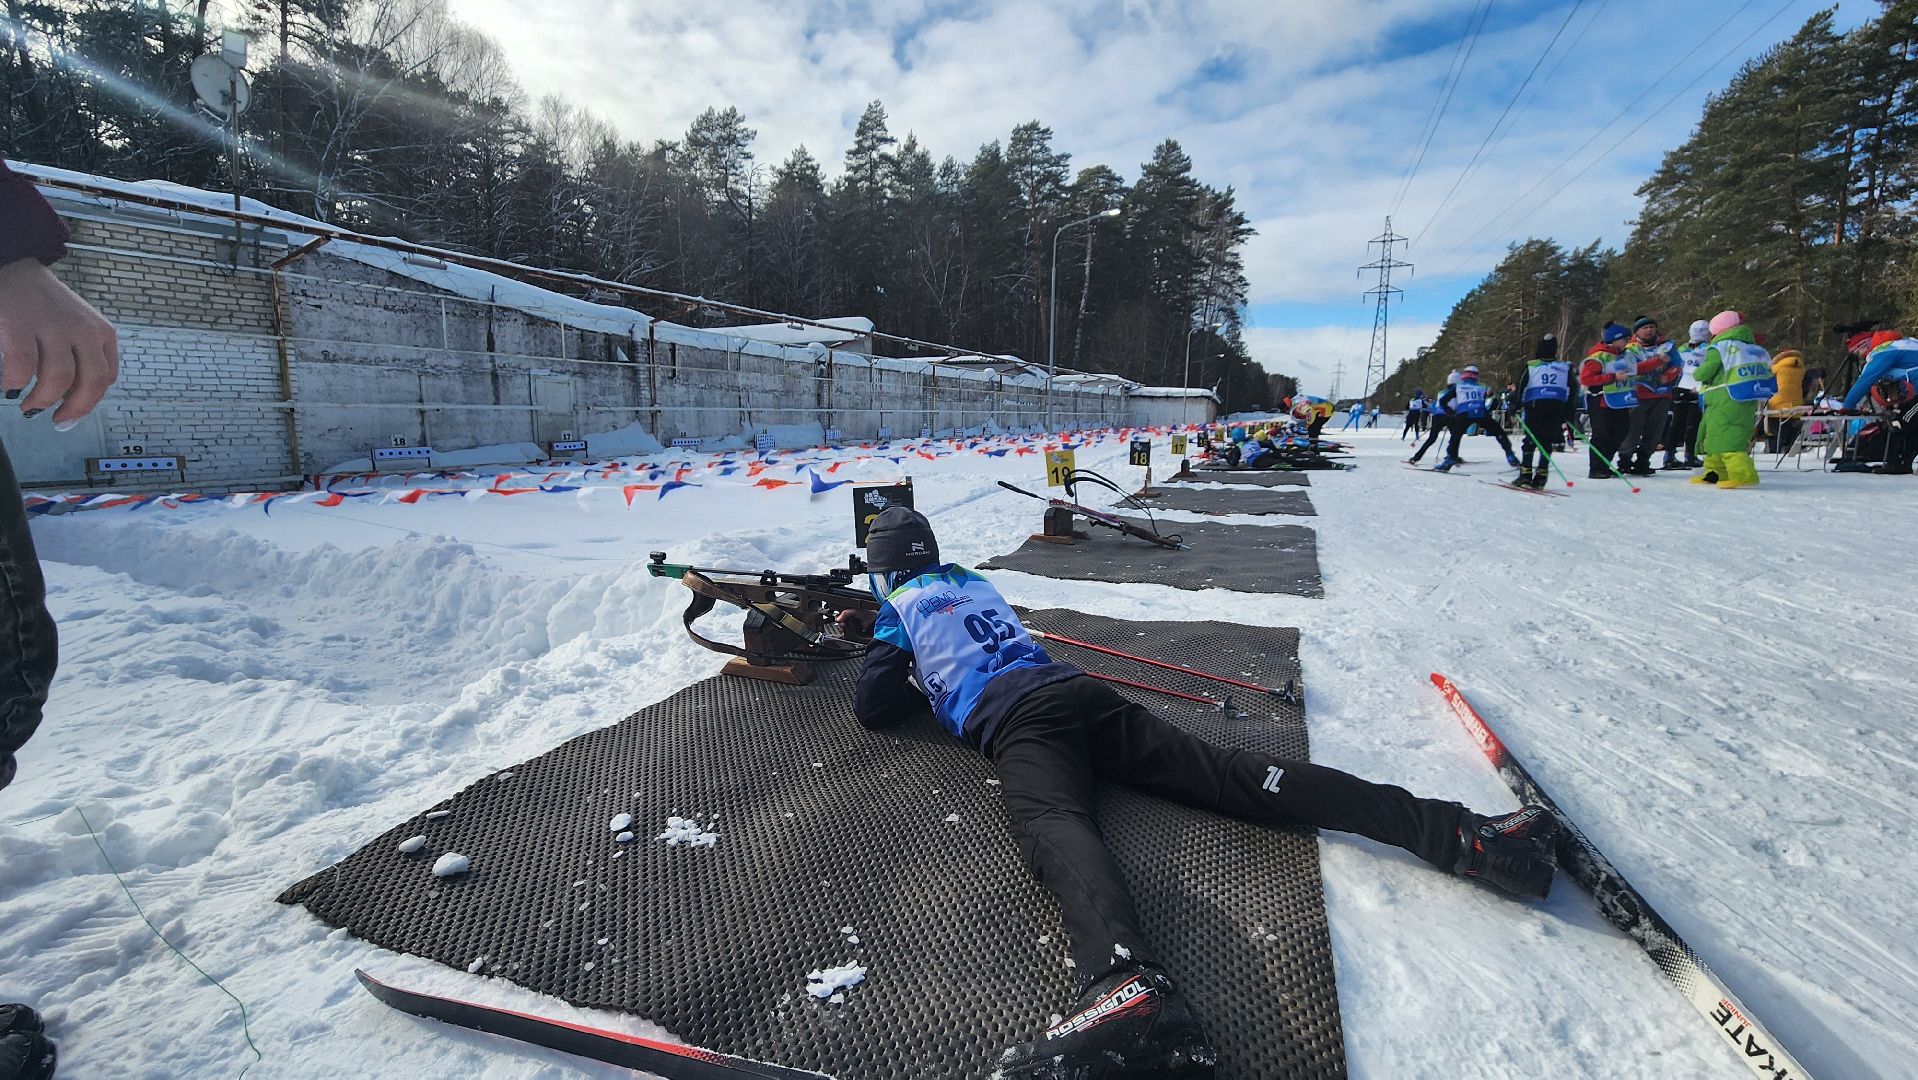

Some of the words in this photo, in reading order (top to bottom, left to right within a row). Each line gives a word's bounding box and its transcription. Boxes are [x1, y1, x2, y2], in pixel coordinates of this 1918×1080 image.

[1541, 373, 1558, 385] 92
[393, 438, 406, 446] 18
[1173, 443, 1184, 454] 17
[122, 445, 144, 455] 19
[1133, 452, 1148, 465] 18
[963, 608, 1016, 655] 95
[1045, 980, 1147, 1041] ROSSIGNOL
[1721, 998, 1753, 1028] JUNIOR
[1709, 1001, 1795, 1080] KATE
